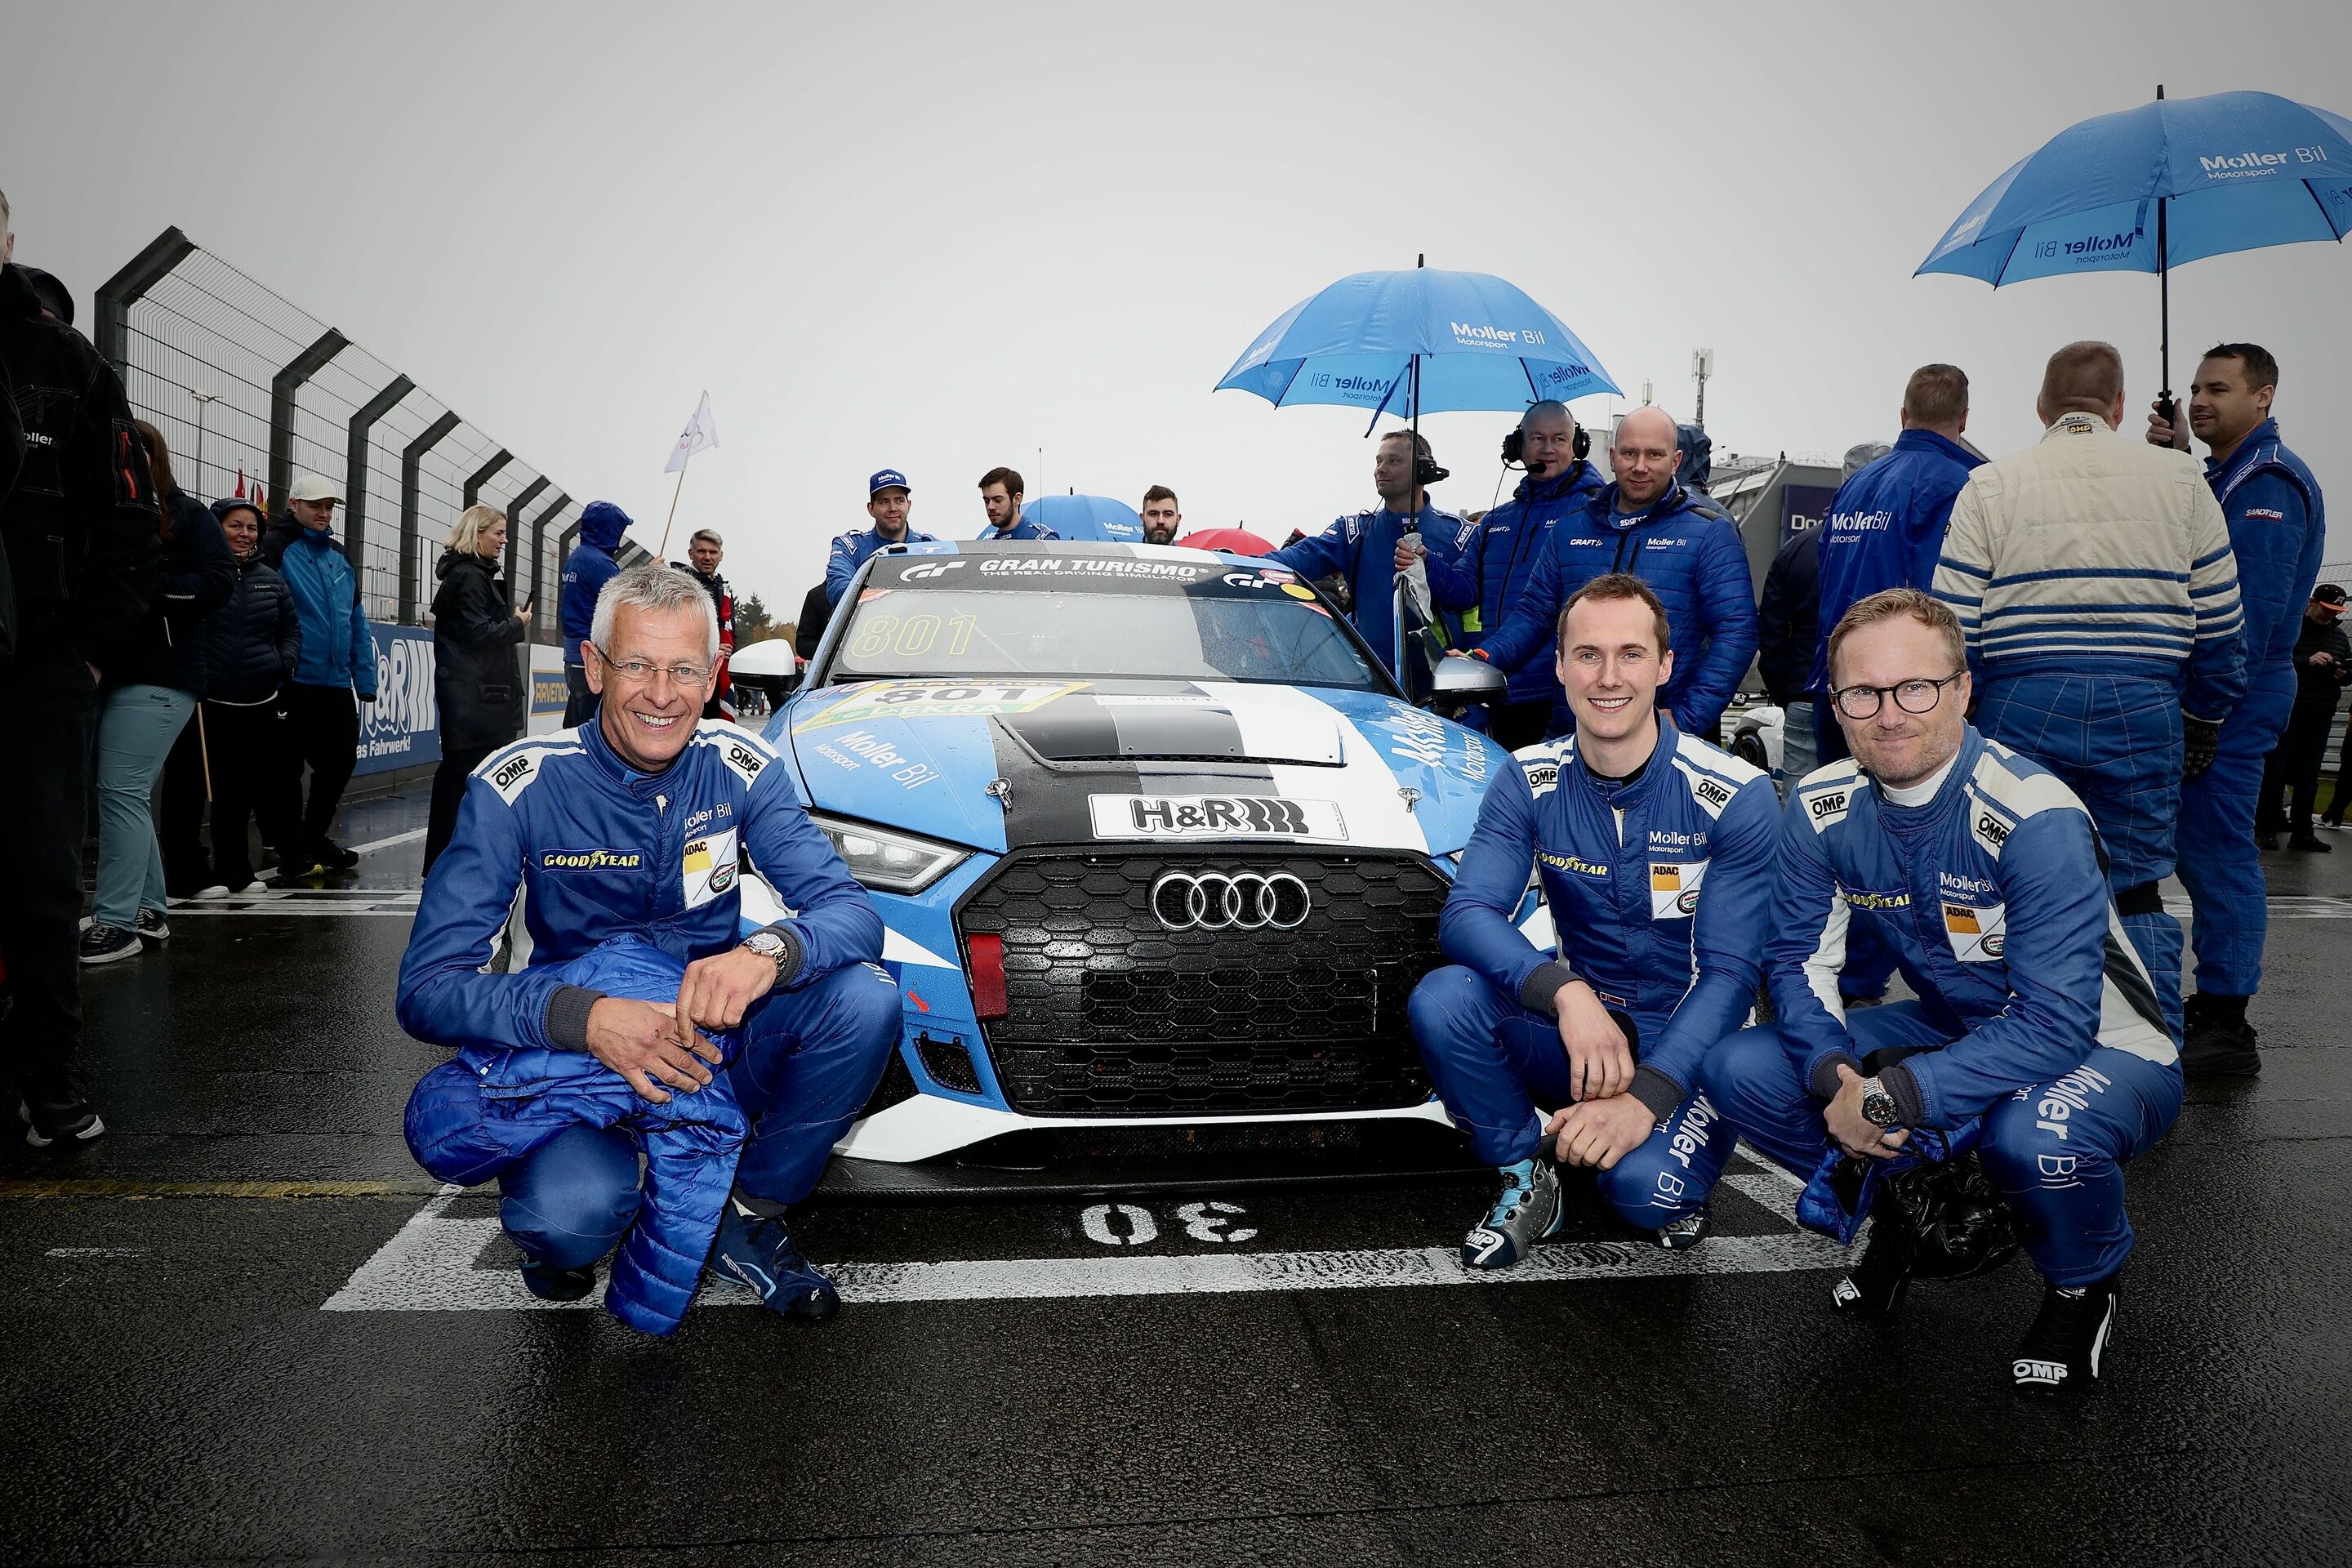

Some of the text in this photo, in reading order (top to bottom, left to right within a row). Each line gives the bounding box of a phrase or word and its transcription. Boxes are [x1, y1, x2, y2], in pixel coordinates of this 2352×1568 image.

[2295, 145, 2328, 163] Bil
[2208, 167, 2277, 179] Motorsport
[1456, 336, 1508, 350] Motorsport
[1521, 329, 1546, 345] Bil
[2070, 425, 2091, 433] OMP
[1872, 510, 1892, 531] Bil
[2245, 508, 2283, 519] SANDTLER
[979, 559, 1062, 571] GRAN
[1116, 572, 1196, 582] SIMULATOR
[851, 614, 977, 657] 801
[875, 688, 1027, 704] 801
[869, 704, 1004, 716] DEKRA
[369, 735, 411, 759] Fahrwerk!
[730, 747, 760, 773] OMP
[812, 742, 862, 771] Motorsport
[495, 758, 529, 786] OMP
[891, 763, 939, 790] Bil
[1529, 770, 1557, 785] OMP
[1698, 782, 1728, 804] OMP
[716, 802, 733, 818] Bil
[1812, 795, 1846, 816] OMP
[1131, 799, 1242, 830] H&R
[1978, 817, 2007, 843] OMP
[1693, 831, 1708, 846] Bil
[684, 841, 708, 858] ADAC
[1648, 844, 1684, 853] Motorsport
[544, 853, 639, 868] GOODYEAR
[1653, 866, 1679, 875] ADAC
[1940, 889, 1977, 901] Motorsport
[1946, 906, 1976, 919] ADAC
[2038, 1154, 2086, 1190] Bil
[1650, 1171, 1686, 1209] Bil
[2013, 1363, 2068, 1381] OMP
